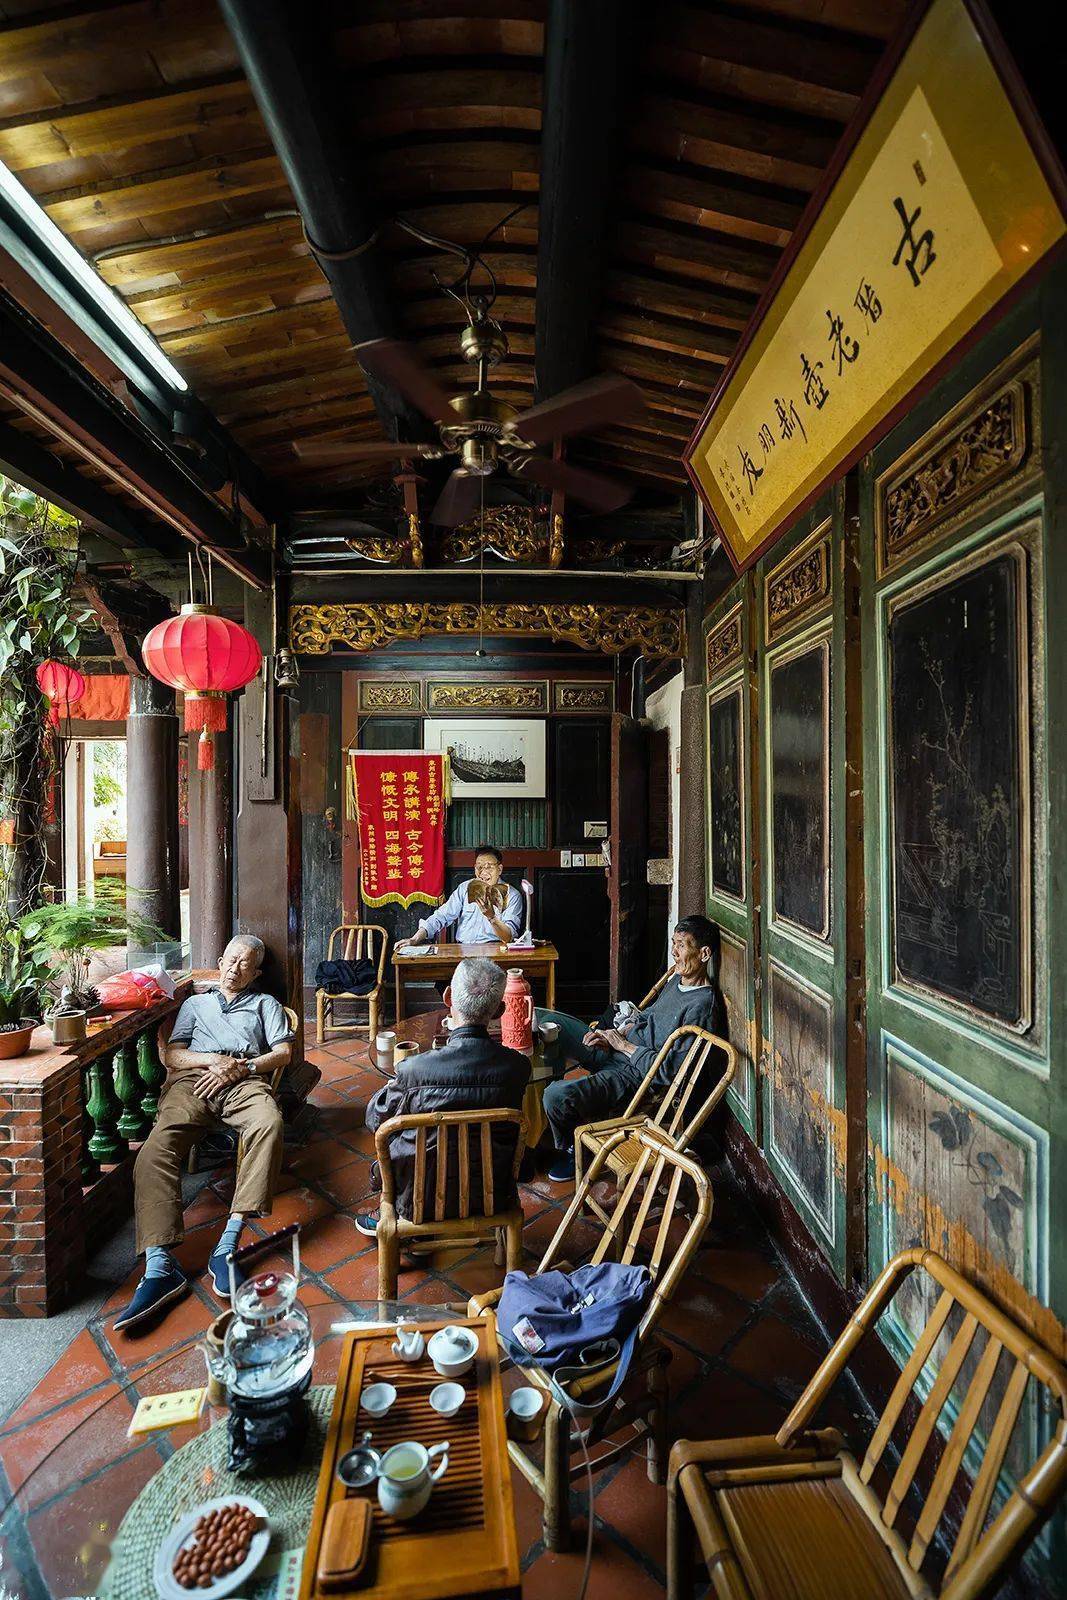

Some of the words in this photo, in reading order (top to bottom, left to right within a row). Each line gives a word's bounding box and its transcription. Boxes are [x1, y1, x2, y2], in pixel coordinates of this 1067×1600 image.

[380, 771, 400, 821] 慷慨文明
[402, 771, 421, 821] 傳承講演
[405, 829, 425, 878] 古今傳奇
